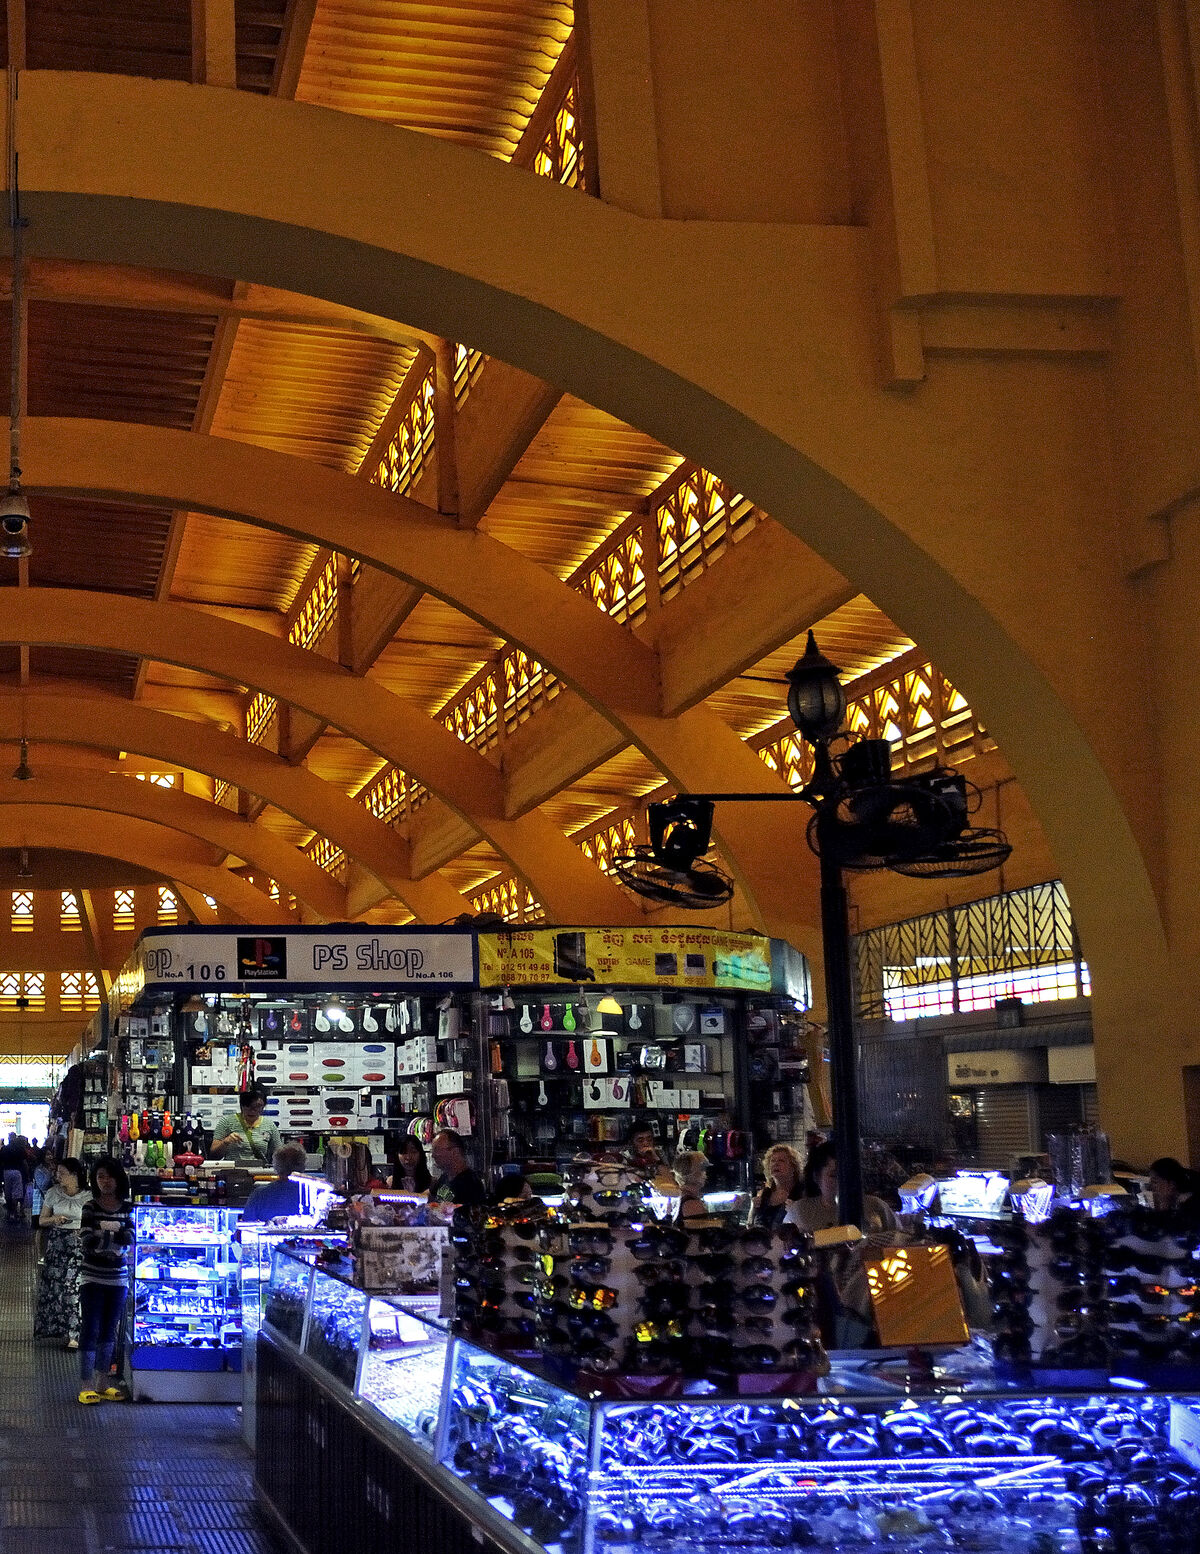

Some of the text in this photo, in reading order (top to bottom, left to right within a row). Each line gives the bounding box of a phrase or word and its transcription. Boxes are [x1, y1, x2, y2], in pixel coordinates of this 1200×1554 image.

[511, 949, 518, 959] A
[520, 948, 535, 959] 105
[313, 939, 424, 977] PS Shop
[625, 957, 651, 966] GAME
[540, 963, 550, 971] 48
[244, 969, 279, 977] PlayStation
[438, 971, 454, 979] 106
